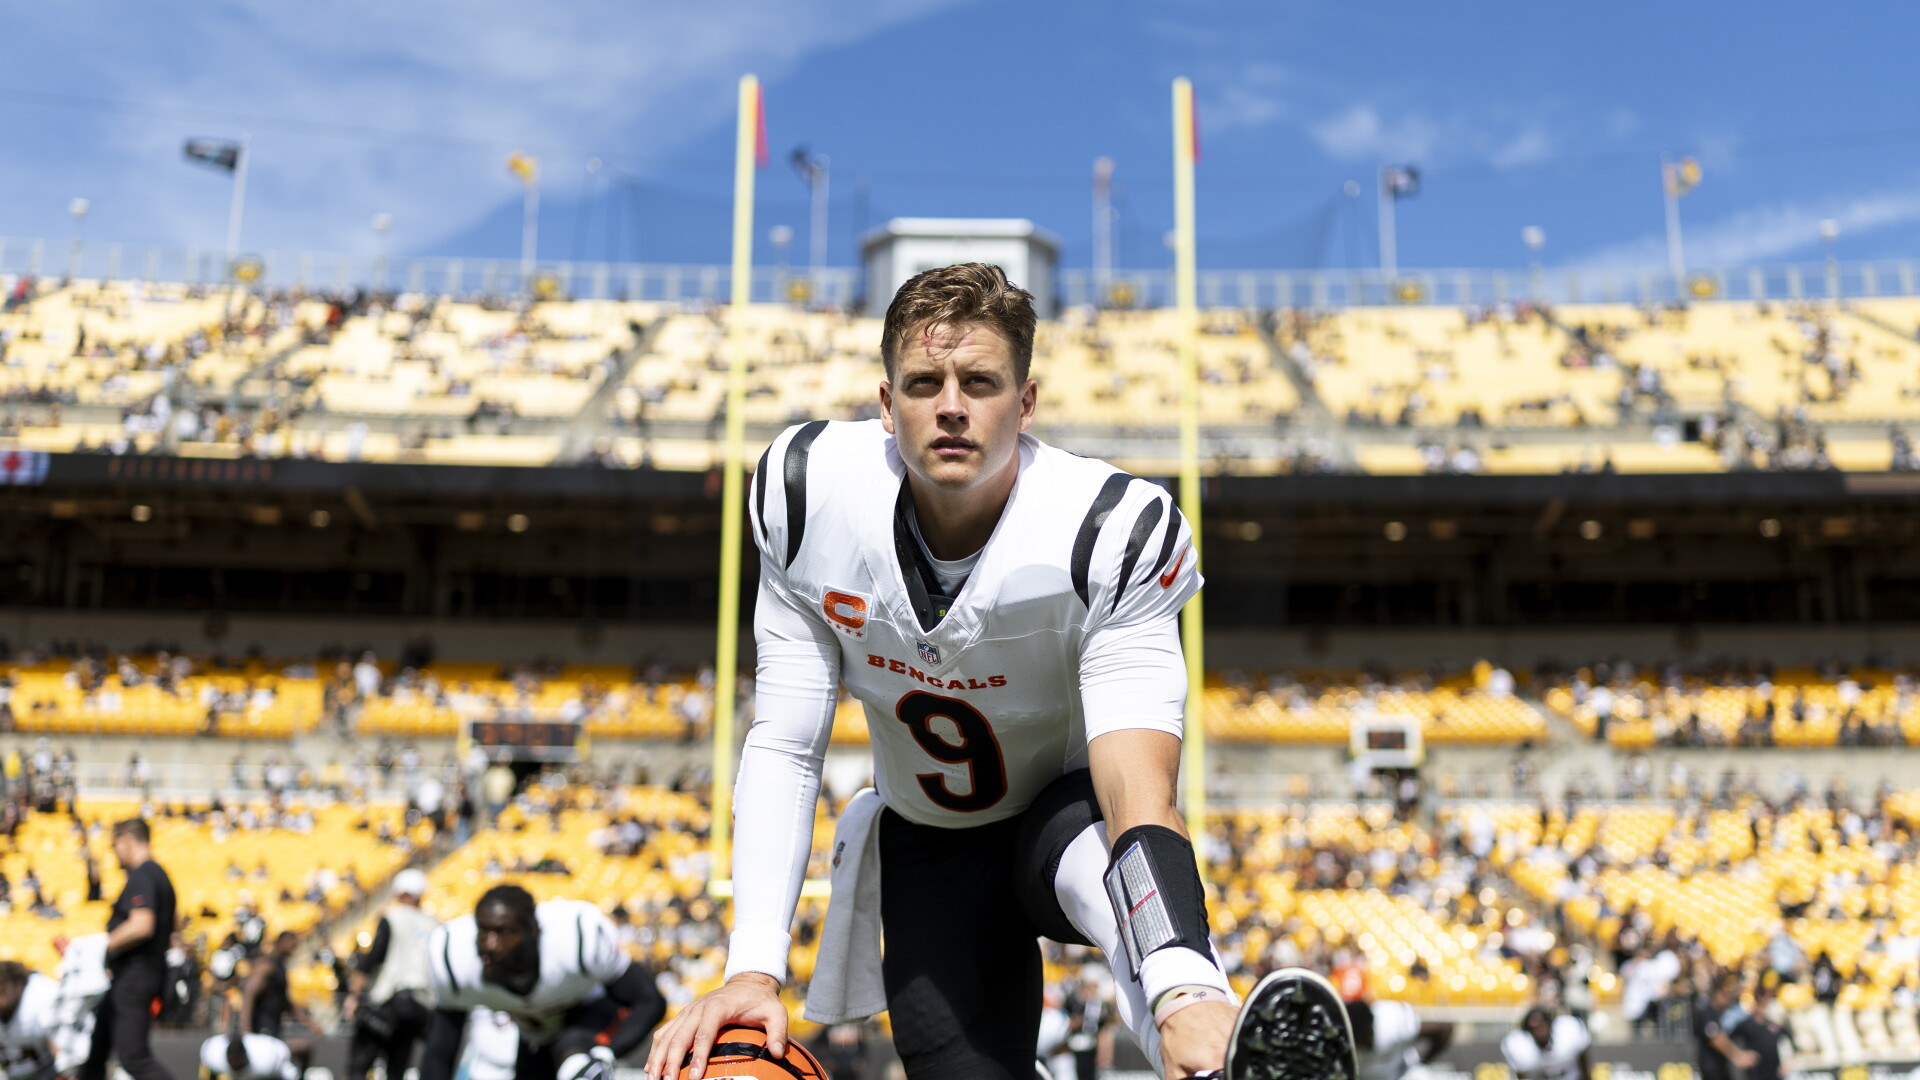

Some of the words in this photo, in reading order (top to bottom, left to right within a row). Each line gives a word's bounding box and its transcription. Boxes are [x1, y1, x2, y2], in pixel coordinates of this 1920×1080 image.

[823, 590, 867, 629] C
[867, 654, 1008, 690] BENGALS
[918, 648, 938, 663] NFL
[895, 689, 1009, 813] 9
